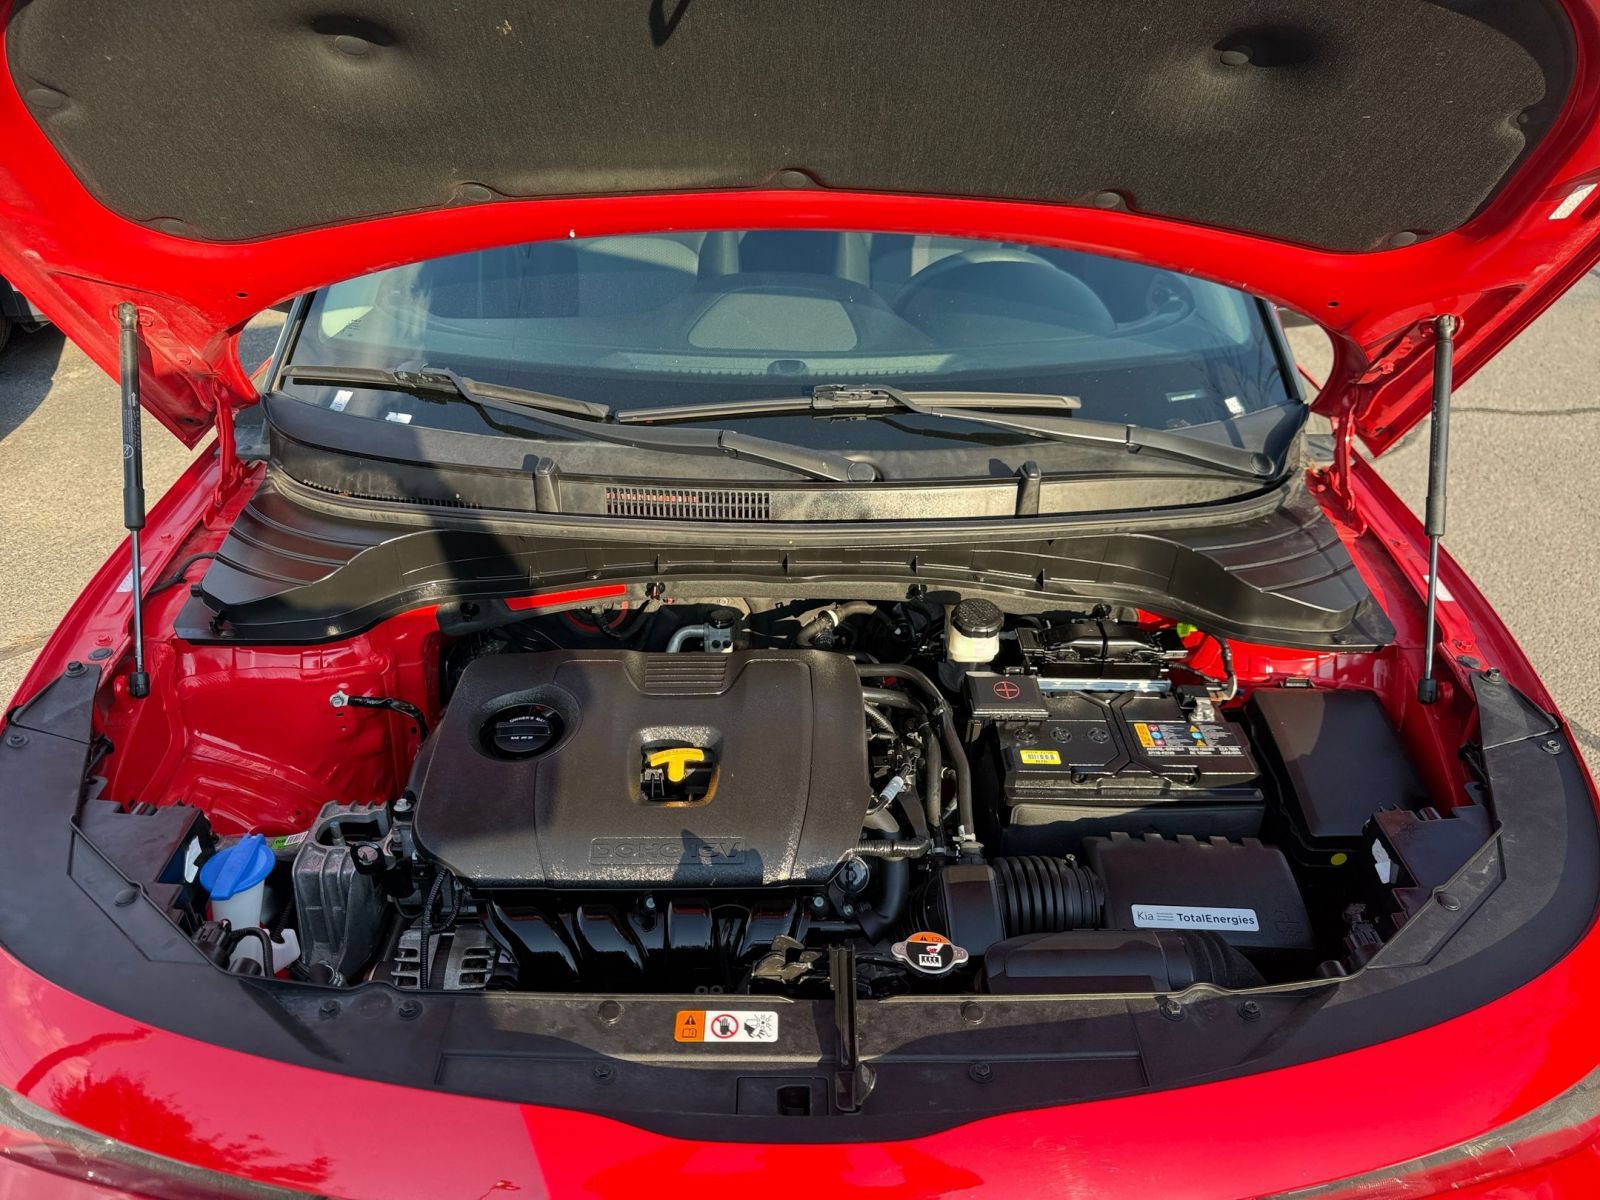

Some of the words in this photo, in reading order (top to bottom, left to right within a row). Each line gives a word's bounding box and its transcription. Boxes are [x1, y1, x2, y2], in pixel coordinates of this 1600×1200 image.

[593, 842, 681, 859] DOHC
[1137, 911, 1154, 921] Kia
[1177, 913, 1255, 926] TotalEnergies
